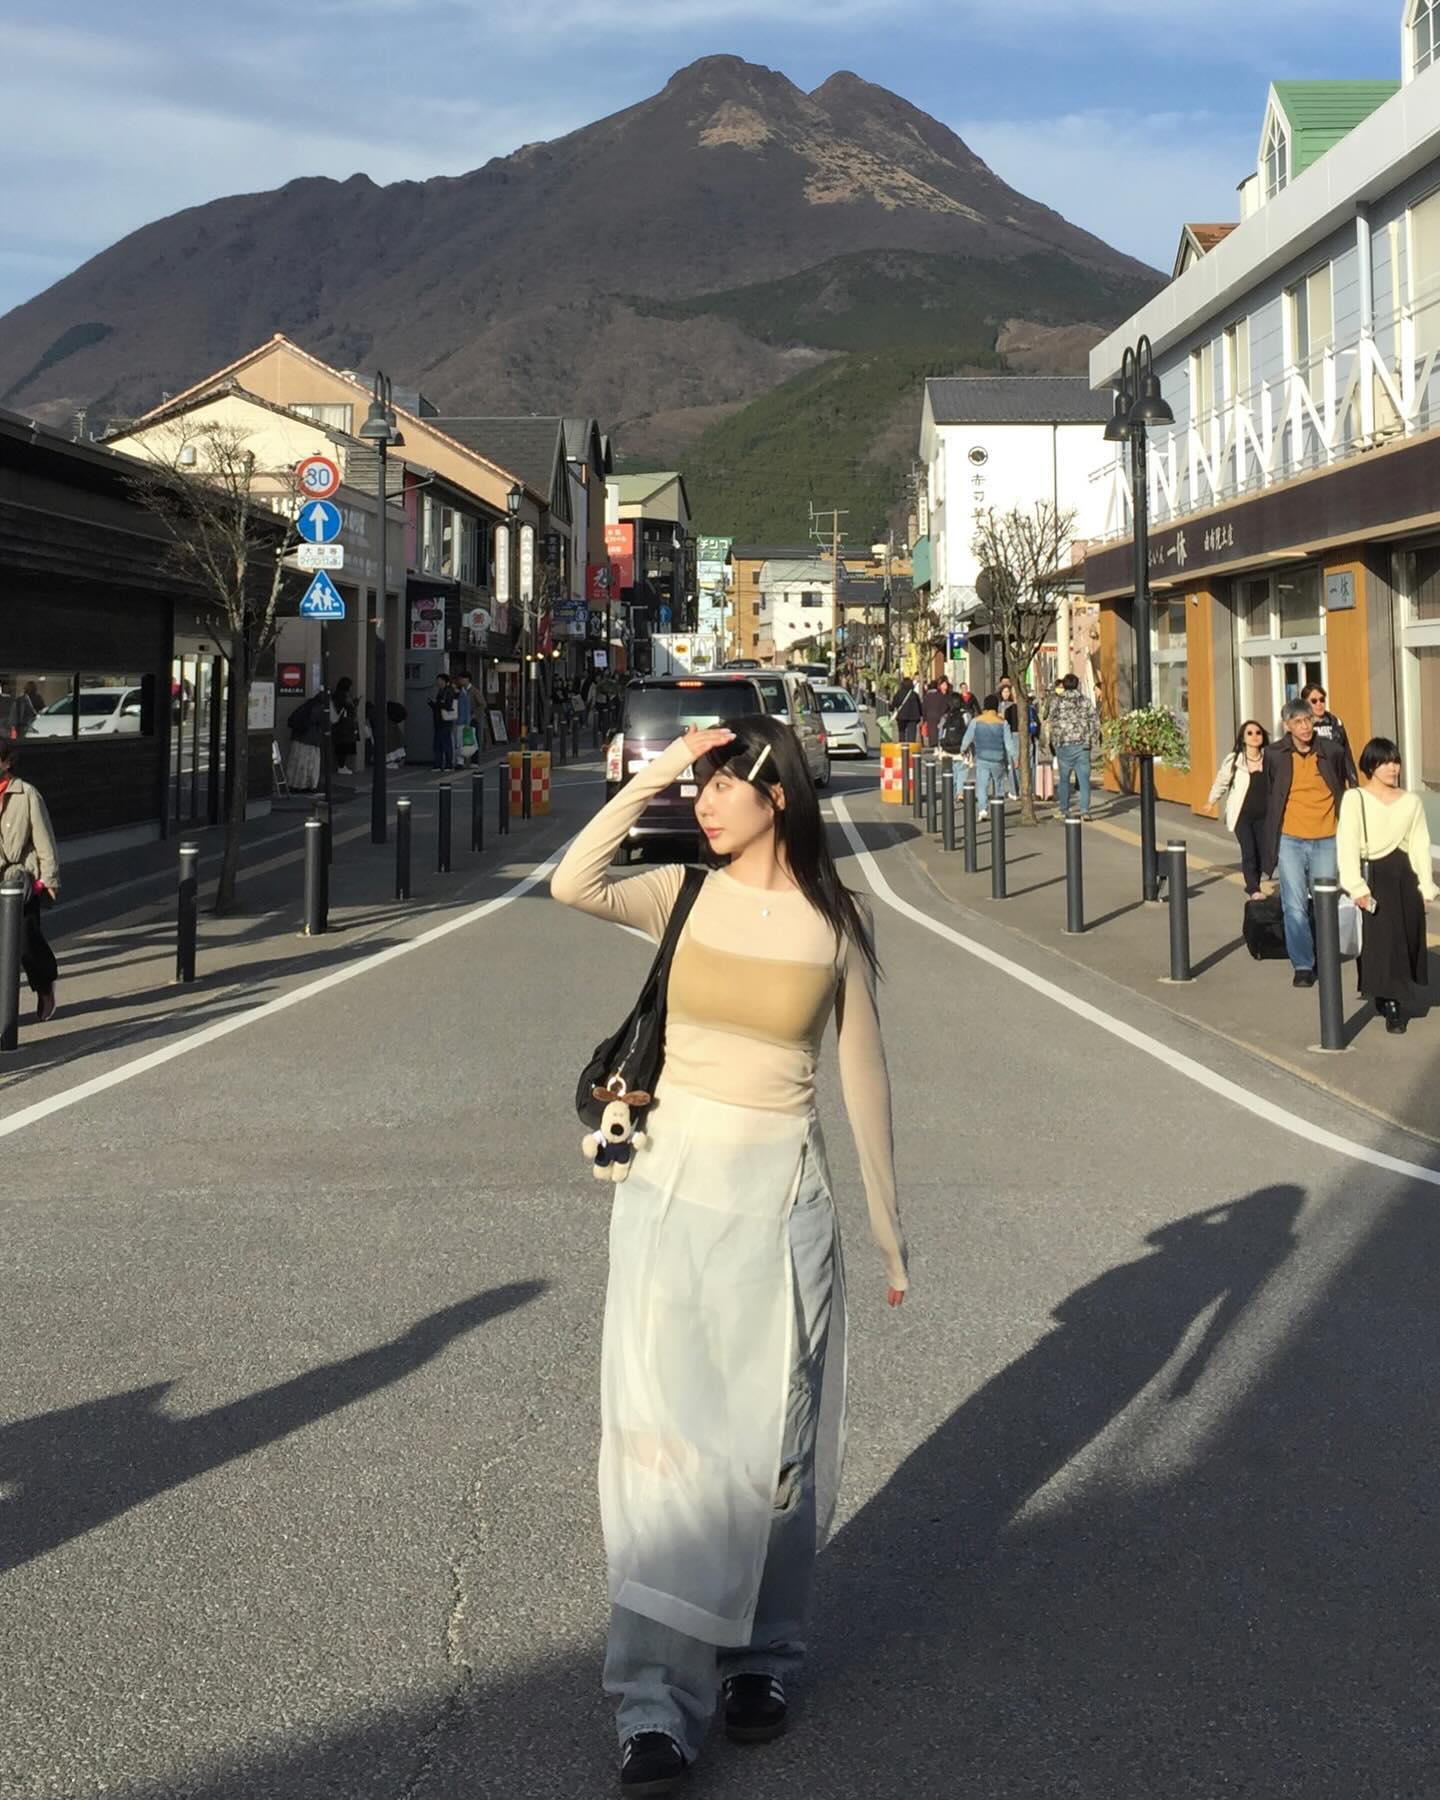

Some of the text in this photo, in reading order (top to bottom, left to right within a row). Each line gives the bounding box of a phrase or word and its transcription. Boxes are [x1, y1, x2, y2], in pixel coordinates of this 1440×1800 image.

[306, 468, 330, 487] 30
[699, 538, 729, 550] チンコ
